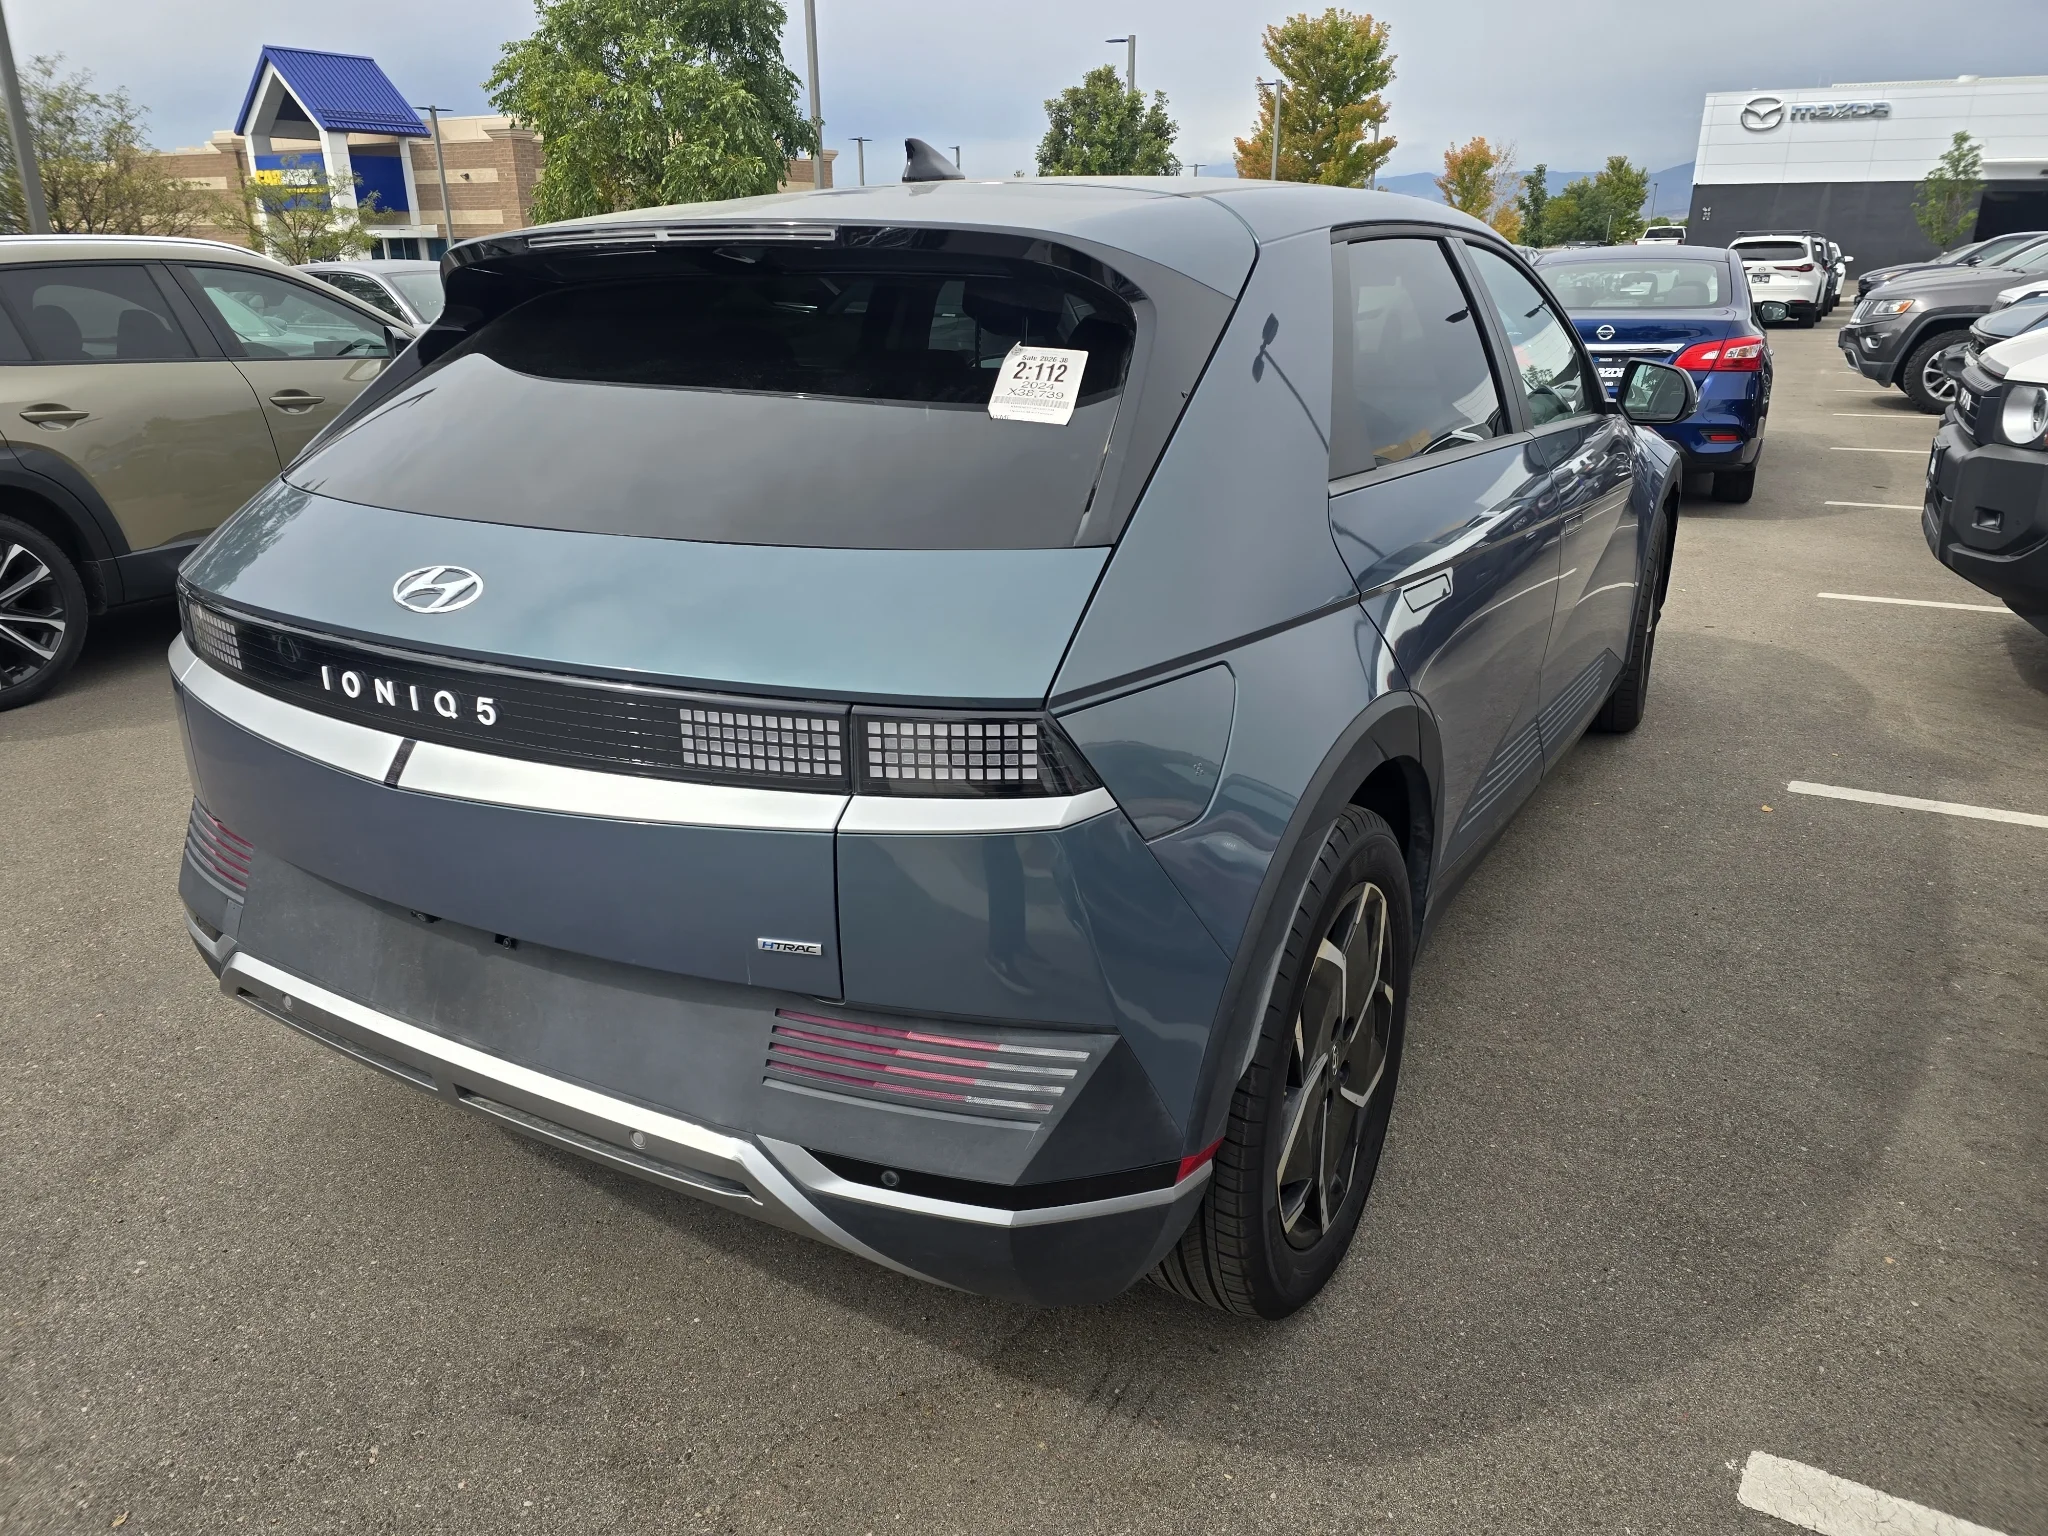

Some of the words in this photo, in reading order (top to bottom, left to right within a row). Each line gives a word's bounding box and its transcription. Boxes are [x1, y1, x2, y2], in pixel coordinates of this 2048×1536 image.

[1790, 101, 1891, 121] mazda
[1013, 361, 1068, 382] 2:112
[1021, 381, 1054, 391] 2024
[321, 665, 458, 719] IONIQ
[476, 696, 497, 726] 5
[762, 941, 817, 954] HTRAC
